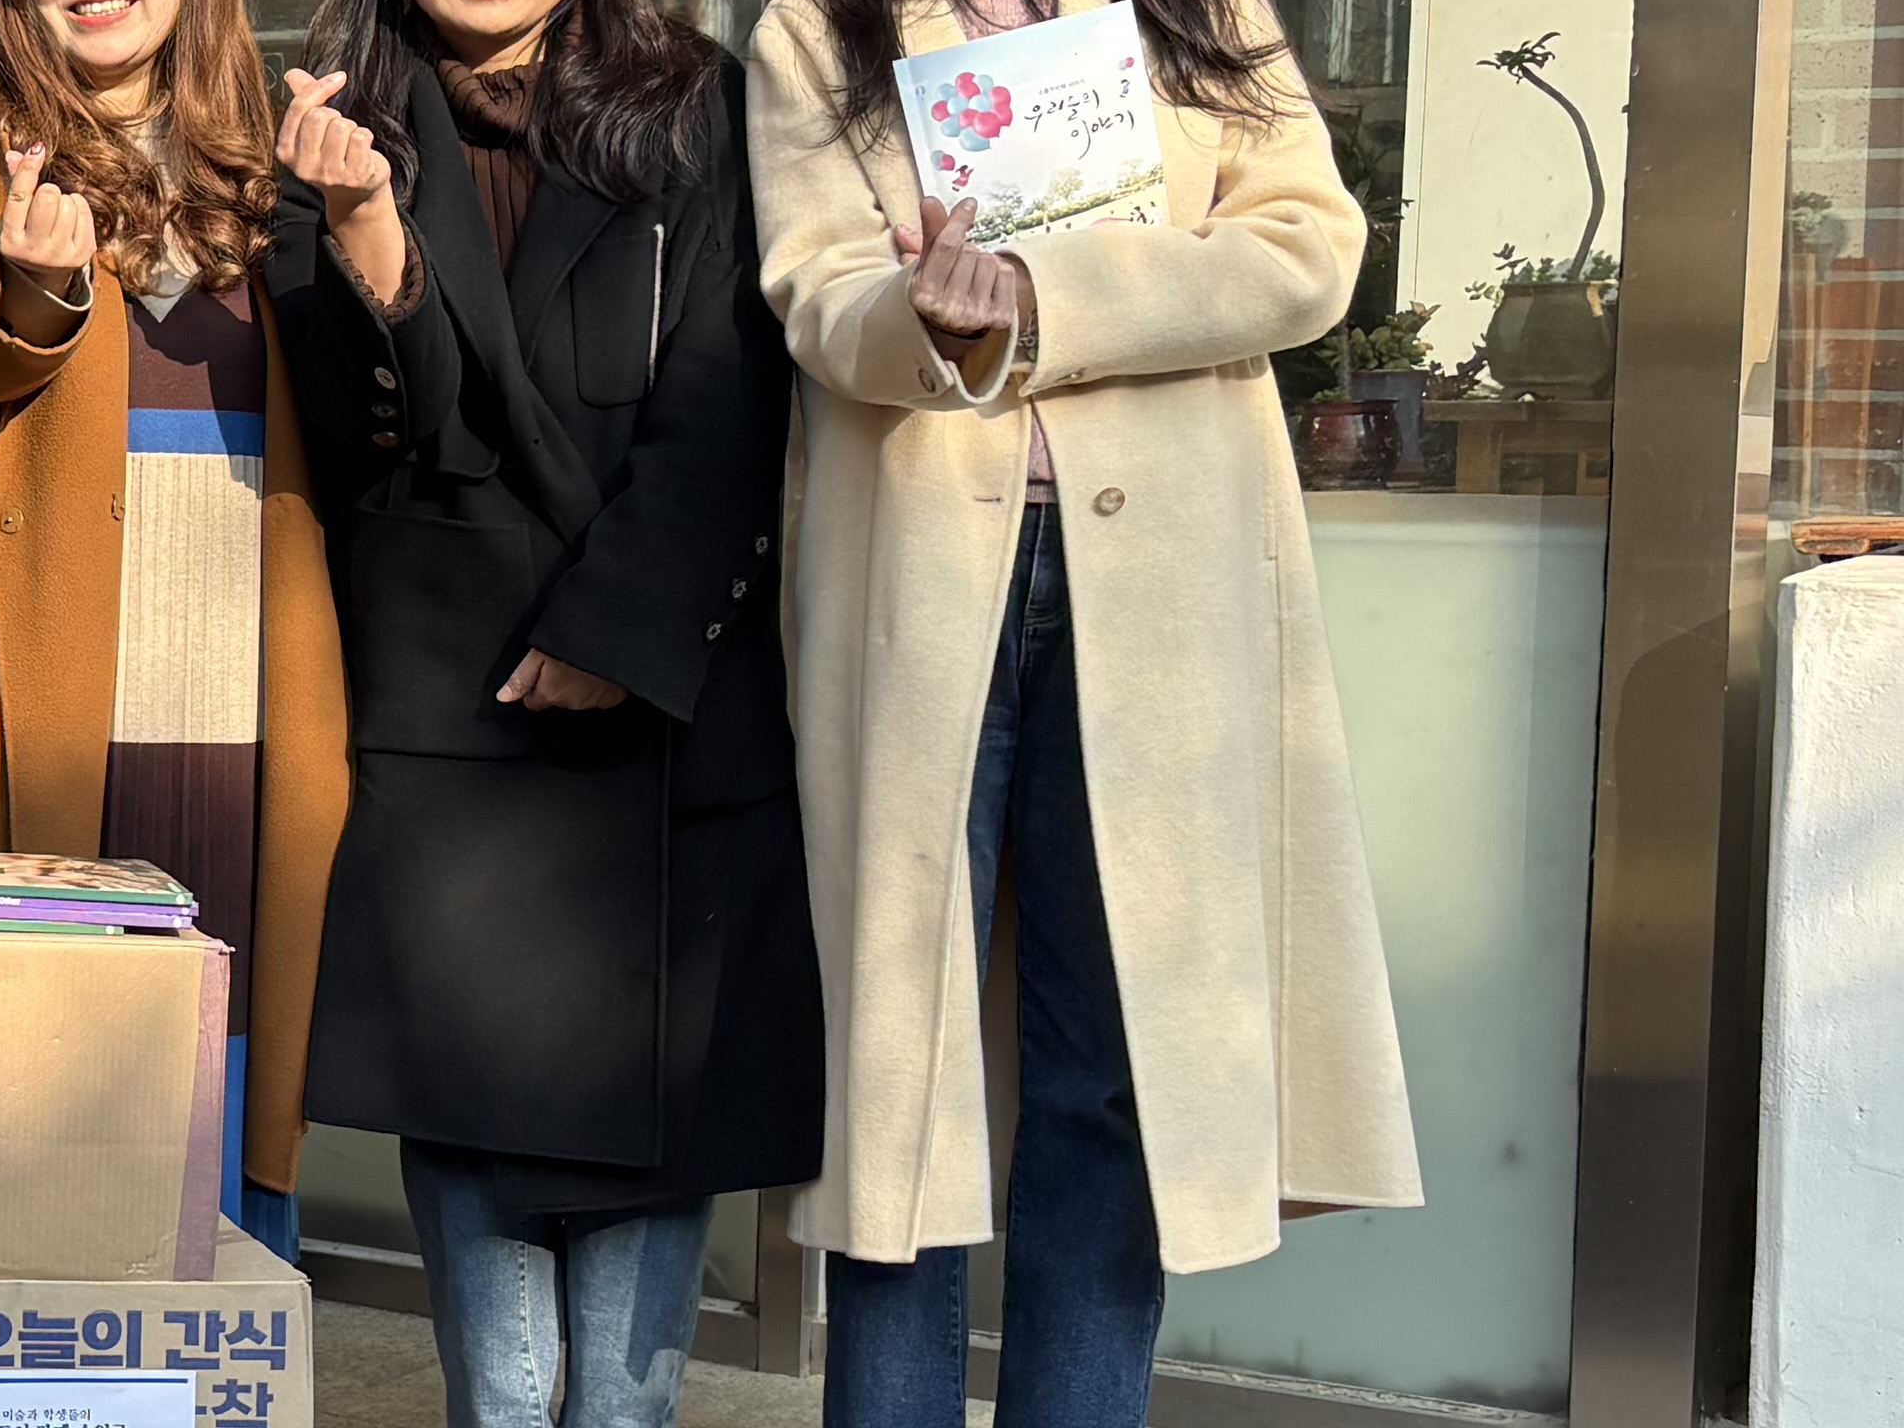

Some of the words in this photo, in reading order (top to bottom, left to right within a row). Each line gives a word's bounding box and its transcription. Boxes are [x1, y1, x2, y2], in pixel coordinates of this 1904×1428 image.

[1024, 88, 1100, 133] 우리들의
[1071, 110, 1135, 160] 이야기
[163, 1310, 287, 1370] 간식
